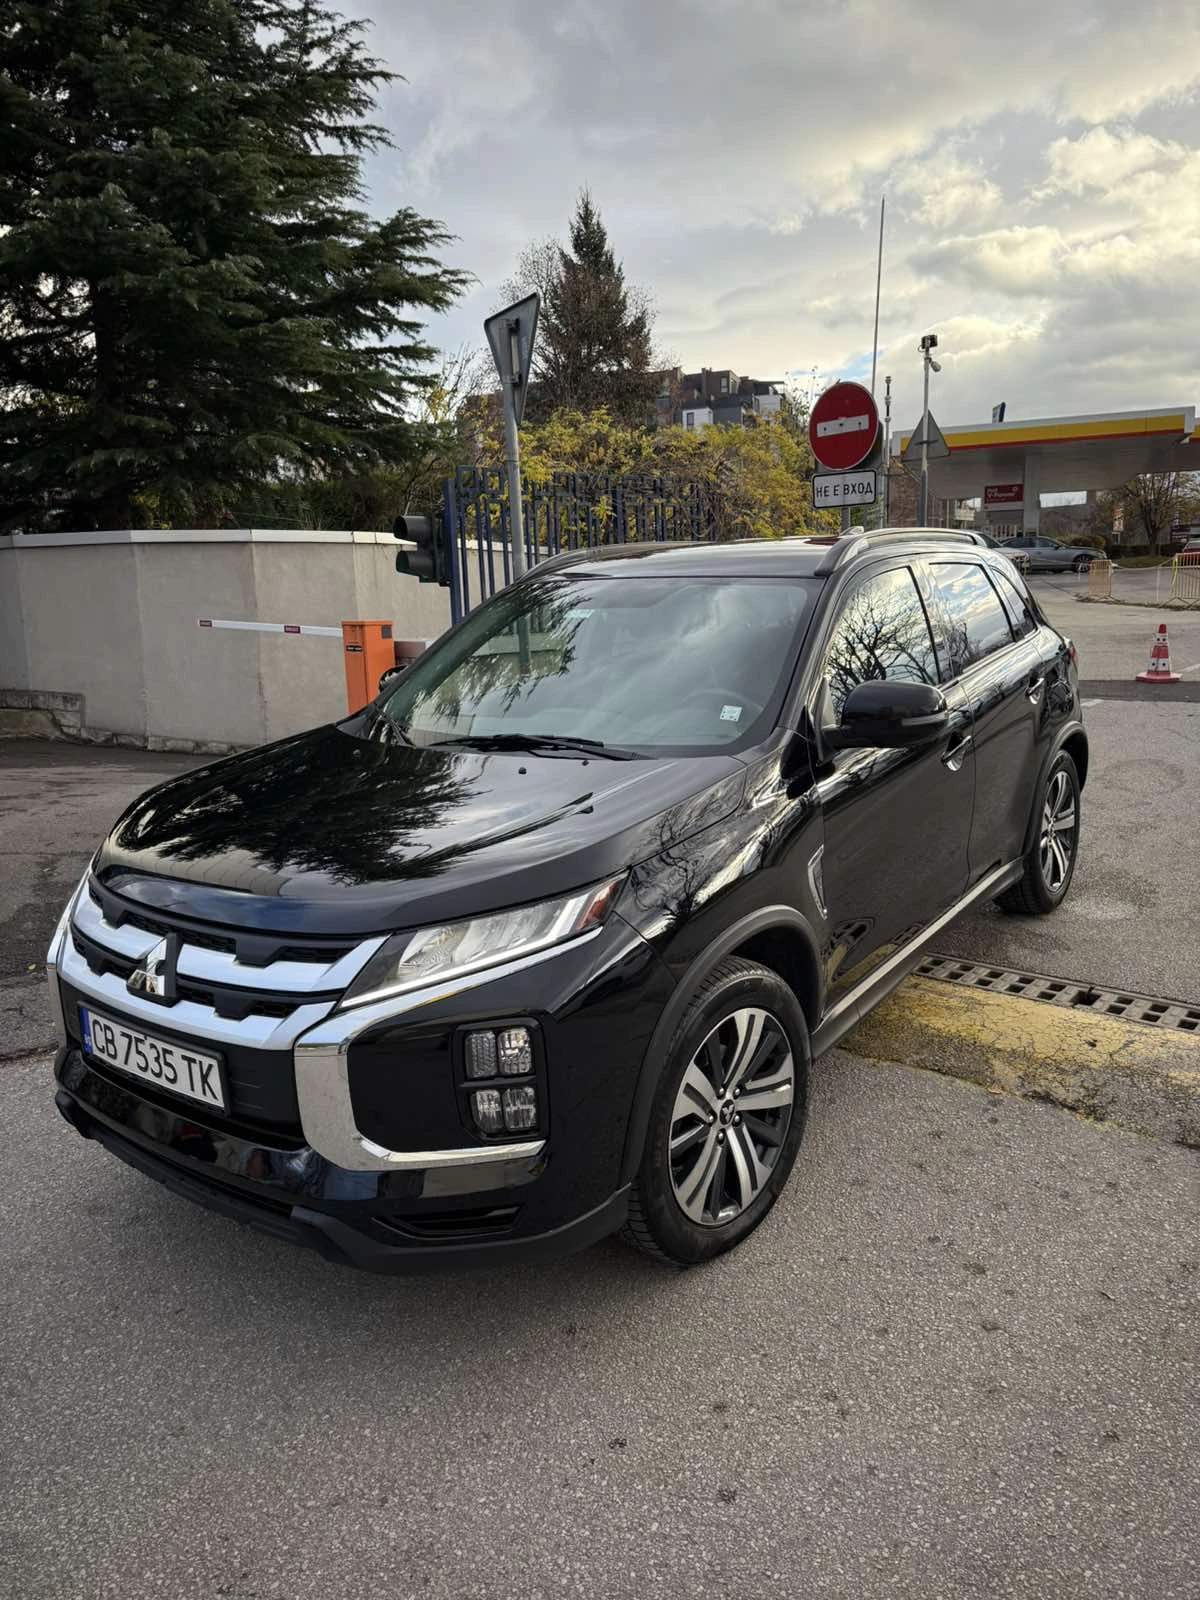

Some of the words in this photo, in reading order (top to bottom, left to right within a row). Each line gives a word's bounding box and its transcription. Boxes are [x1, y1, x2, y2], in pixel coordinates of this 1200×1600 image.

[816, 486, 830, 498] НЕ
[833, 484, 840, 496] Е
[843, 481, 873, 496] ВХОД
